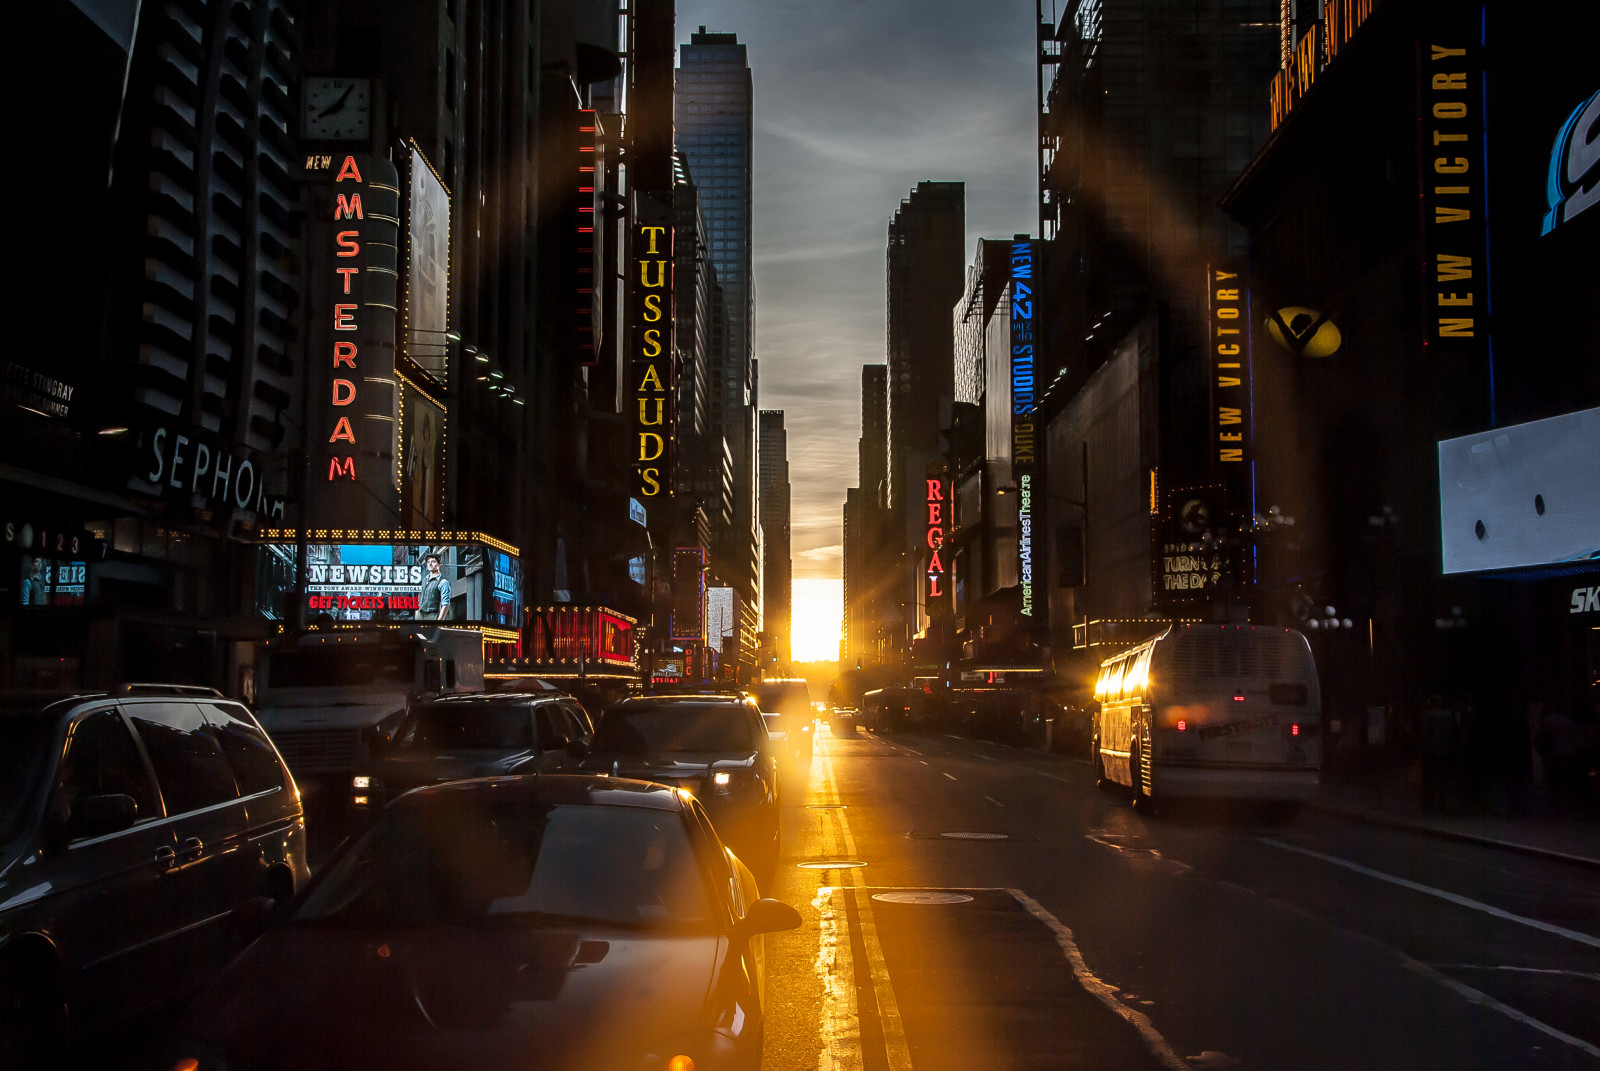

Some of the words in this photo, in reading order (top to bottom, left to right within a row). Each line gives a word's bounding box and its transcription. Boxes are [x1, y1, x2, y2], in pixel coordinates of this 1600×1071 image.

[1431, 44, 1471, 224] VICTORY
[1012, 242, 1032, 279] NEW
[1437, 253, 1475, 337] NEW
[305, 156, 332, 170] NEW
[329, 155, 363, 482] AMSTERDAM
[1216, 270, 1241, 388] VICTORY
[638, 226, 668, 496] TUSSAUD'S
[1013, 344, 1034, 415] STUDIOS
[32, 371, 74, 402] STINGRAY
[1014, 423, 1034, 464] DUKE
[1219, 407, 1243, 462] NEW
[57, 533, 64, 551] 2
[72, 536, 79, 554] 3
[101, 542, 108, 559] 7
[926, 479, 944, 597] REGAL
[309, 565, 422, 583] NEWSIES
[1163, 555, 1200, 573] TURN
[1163, 573, 1188, 590] THE
[309, 596, 334, 609] GET
[336, 596, 385, 609] TICKETS
[388, 596, 420, 609] HERE
[1569, 586, 1600, 614] SK
